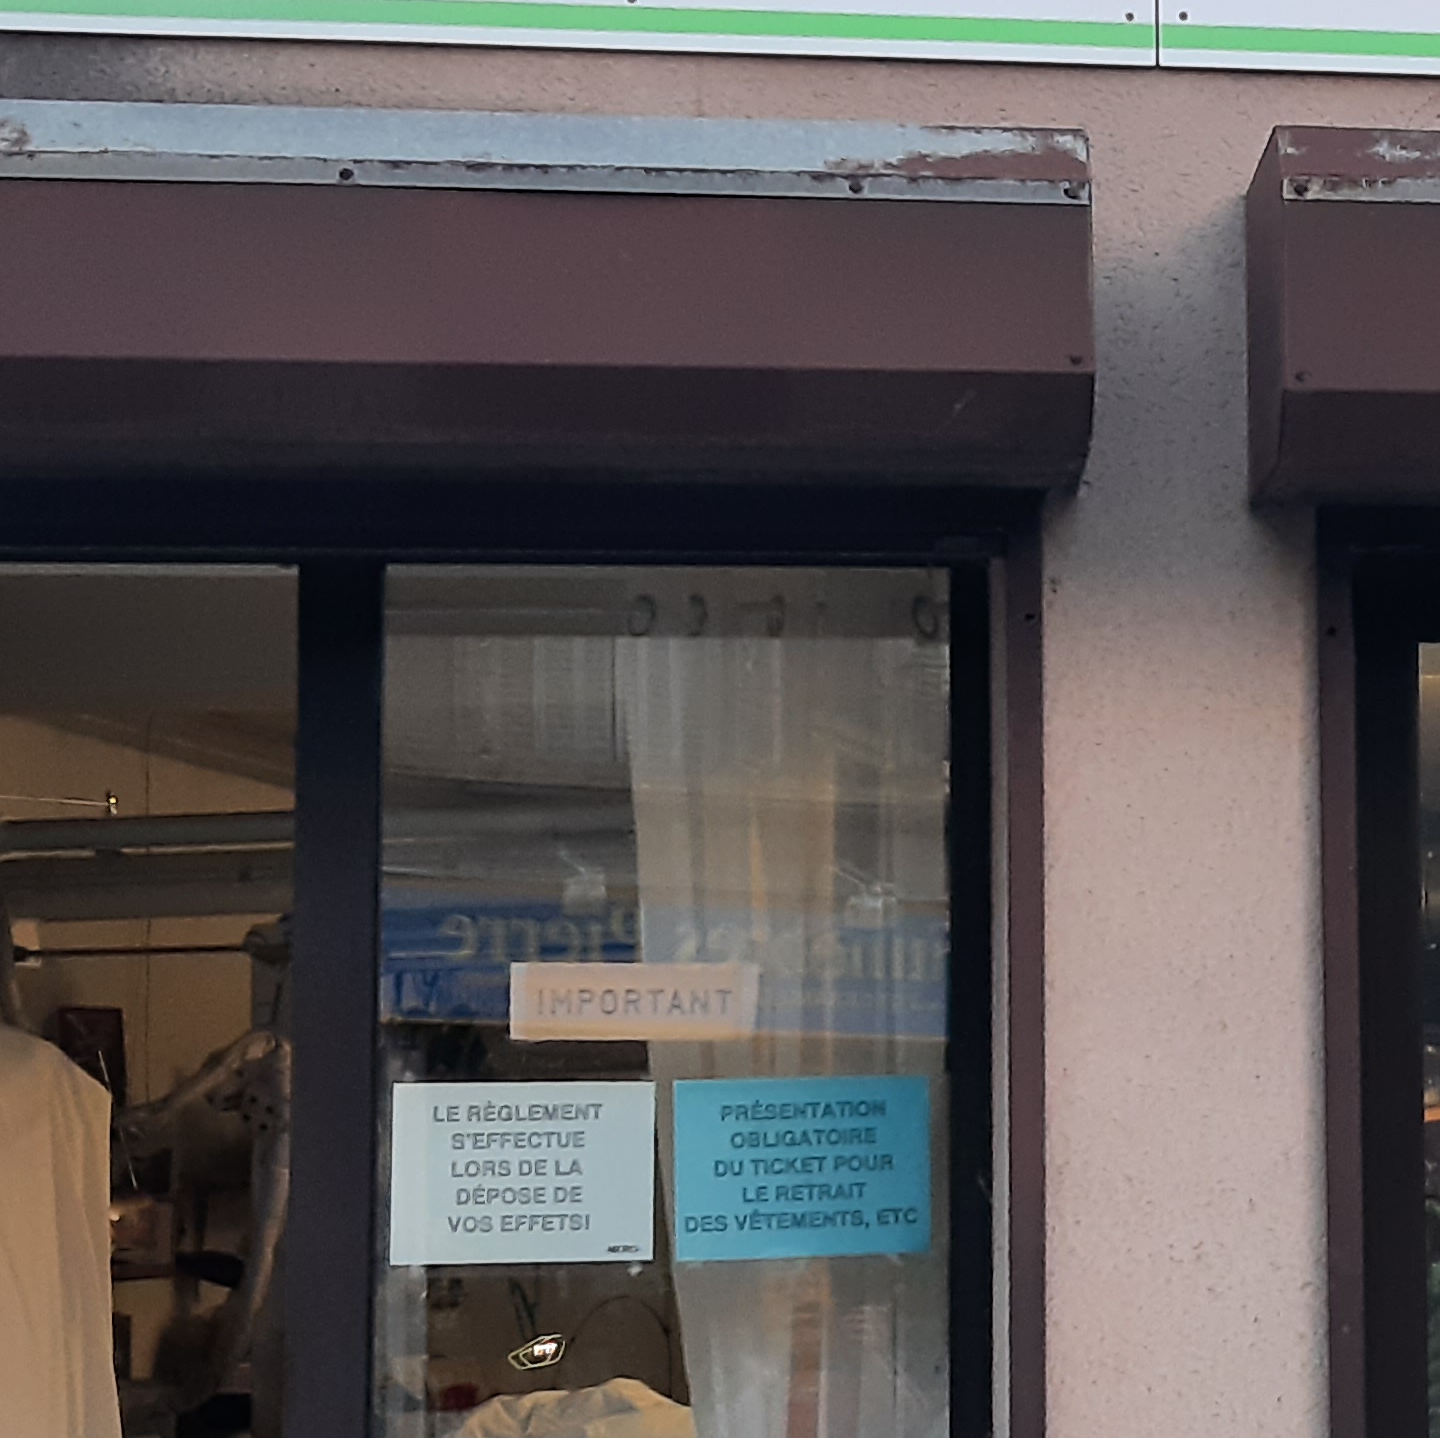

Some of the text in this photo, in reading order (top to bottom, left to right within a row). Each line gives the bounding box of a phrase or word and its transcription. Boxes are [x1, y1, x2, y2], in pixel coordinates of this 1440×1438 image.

[536, 988, 736, 1018] IMPORTANT
[432, 1104, 461, 1123] LE
[720, 1099, 887, 1122] PRÉSENTATION
[451, 1131, 586, 1151] S'EFFECTUE
[729, 1126, 878, 1149] OBLIGATOIRE
[451, 1158, 583, 1178] LORS DE LA
[713, 1153, 895, 1177] DU TICKET POUR
[455, 1184, 584, 1206] DÉPOSE DE
[742, 1181, 868, 1203] LE RETRAIT
[447, 1213, 591, 1234] VOS EFFETS!
[684, 1208, 918, 1234] DES VÊTEMENTS, ETC
